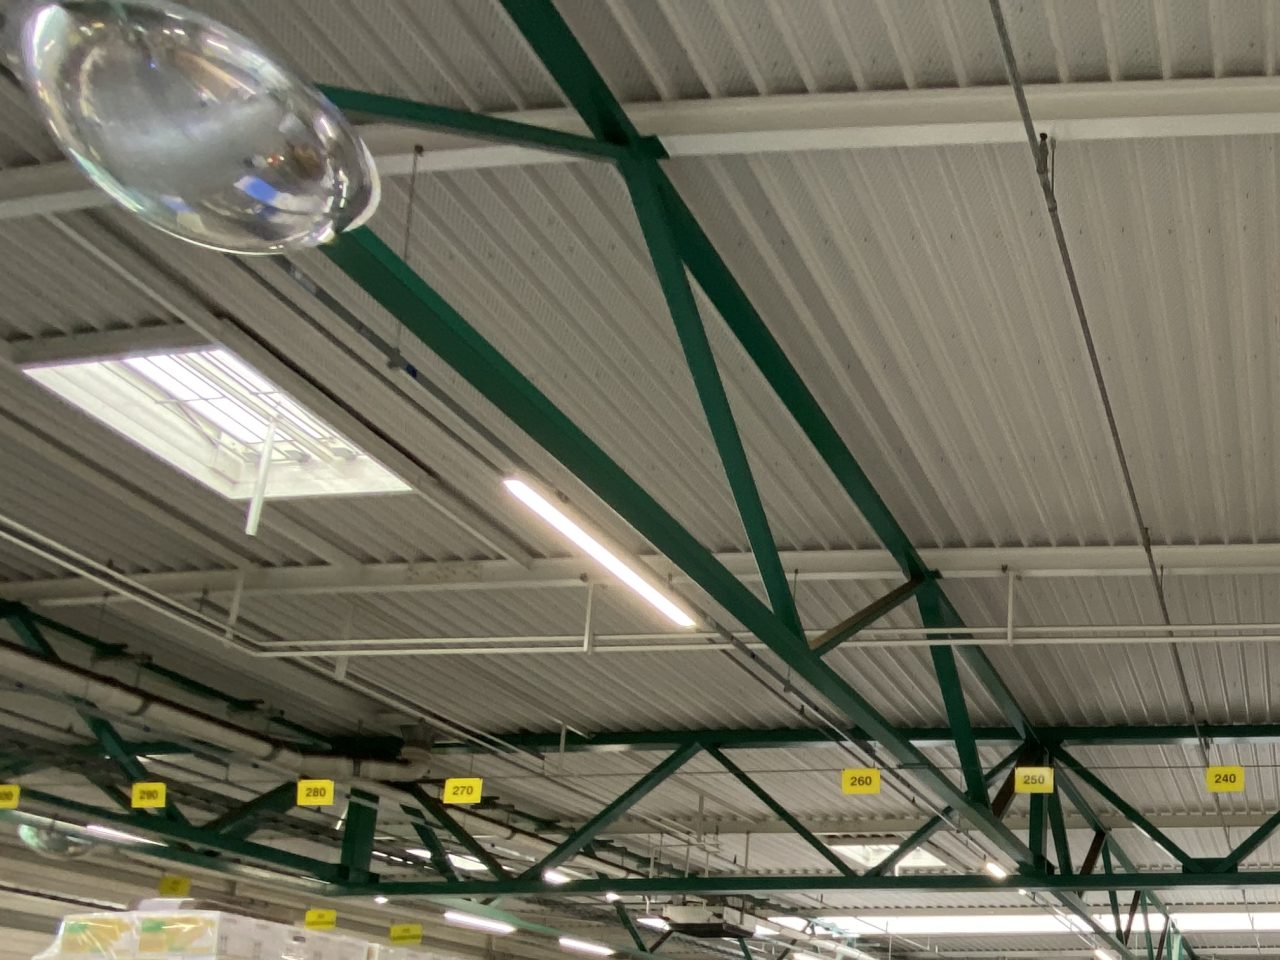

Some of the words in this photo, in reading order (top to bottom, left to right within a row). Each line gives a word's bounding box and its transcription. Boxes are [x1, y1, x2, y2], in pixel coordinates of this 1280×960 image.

[850, 775, 872, 787] 260
[1023, 774, 1045, 785] 250
[1214, 773, 1237, 784] 240
[305, 787, 326, 798] 280
[452, 786, 474, 796] 270
